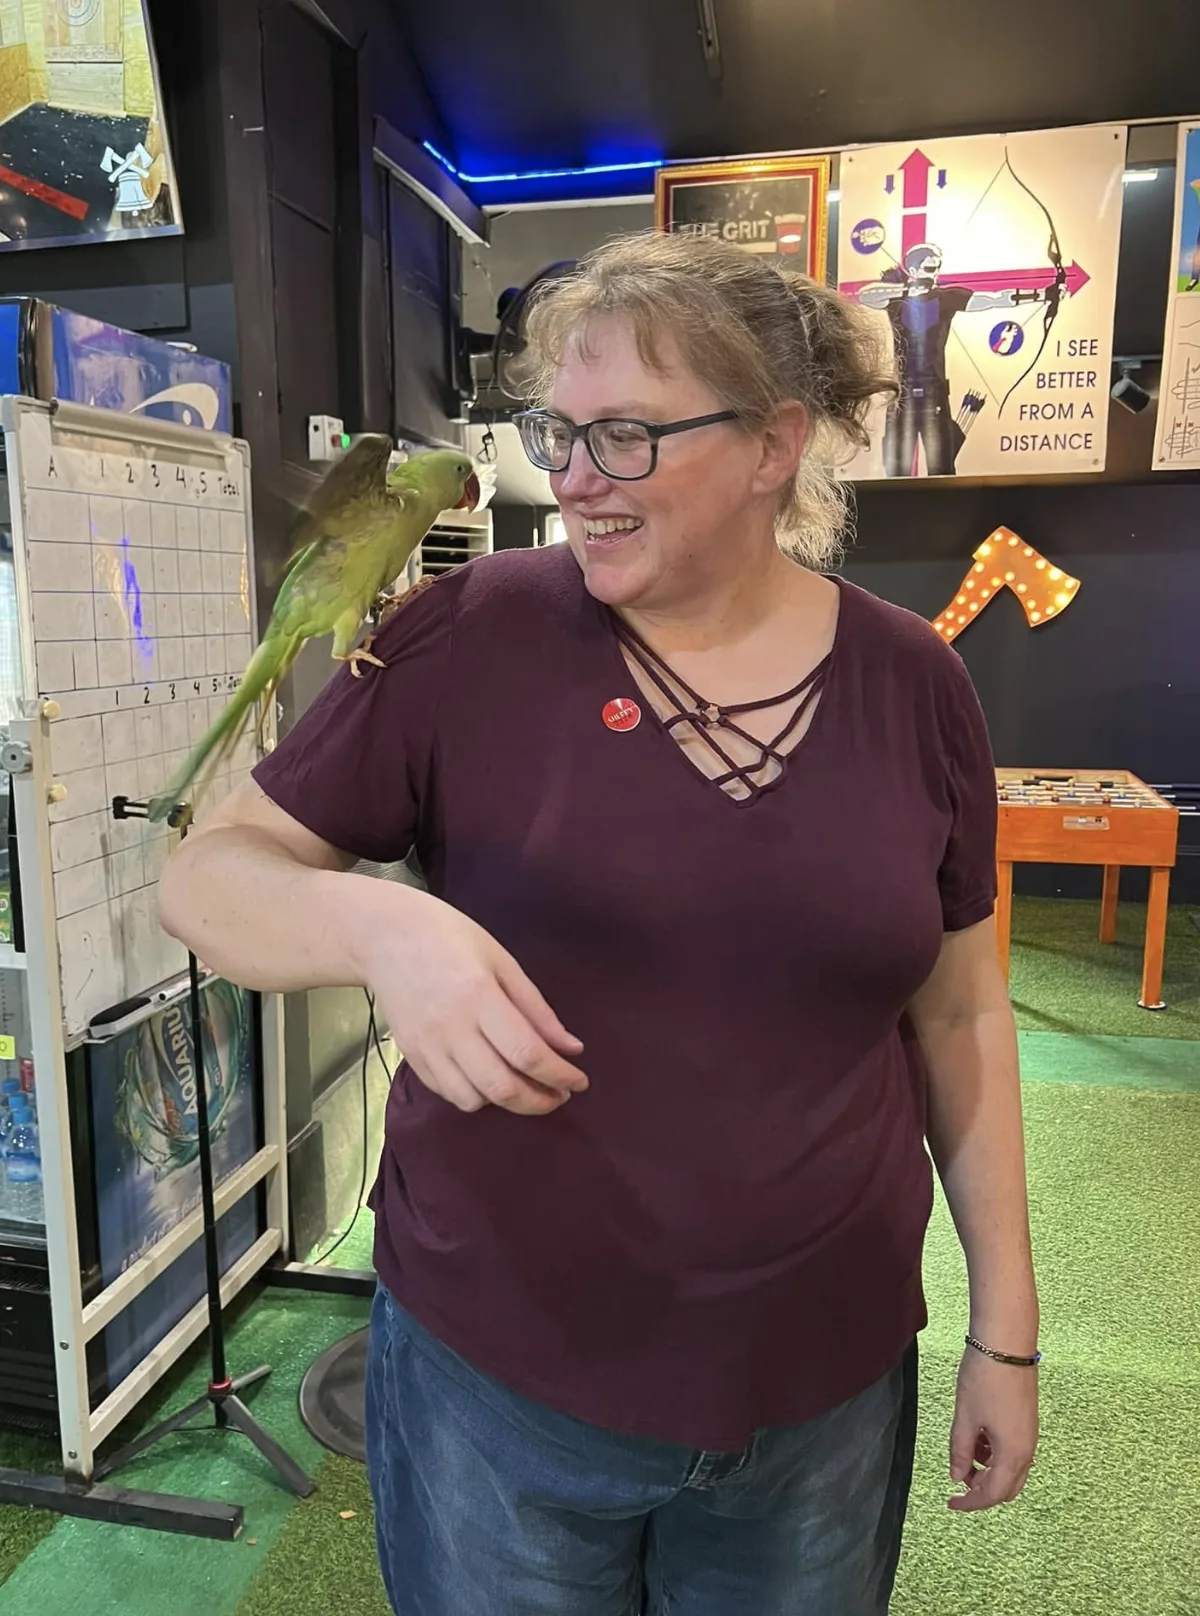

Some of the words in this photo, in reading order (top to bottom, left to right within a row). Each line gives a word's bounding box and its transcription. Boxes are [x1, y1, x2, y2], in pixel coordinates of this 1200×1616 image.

[722, 219, 770, 241] GRIT
[1056, 340, 1061, 357] I
[1067, 339, 1098, 357] SEE
[1036, 371, 1097, 389] BETTER
[1019, 403, 1074, 421] FROM
[1081, 402, 1094, 419] A
[1000, 433, 1093, 452] DISTANCE
[48, 455, 58, 478] A
[125, 462, 135, 483] 2
[151, 463, 160, 488] 3
[175, 466, 187, 488] 4
[143, 686, 150, 705] 2
[168, 682, 176, 700] 3
[193, 680, 201, 695] 4
[164, 1003, 198, 1116] AQUARIU
